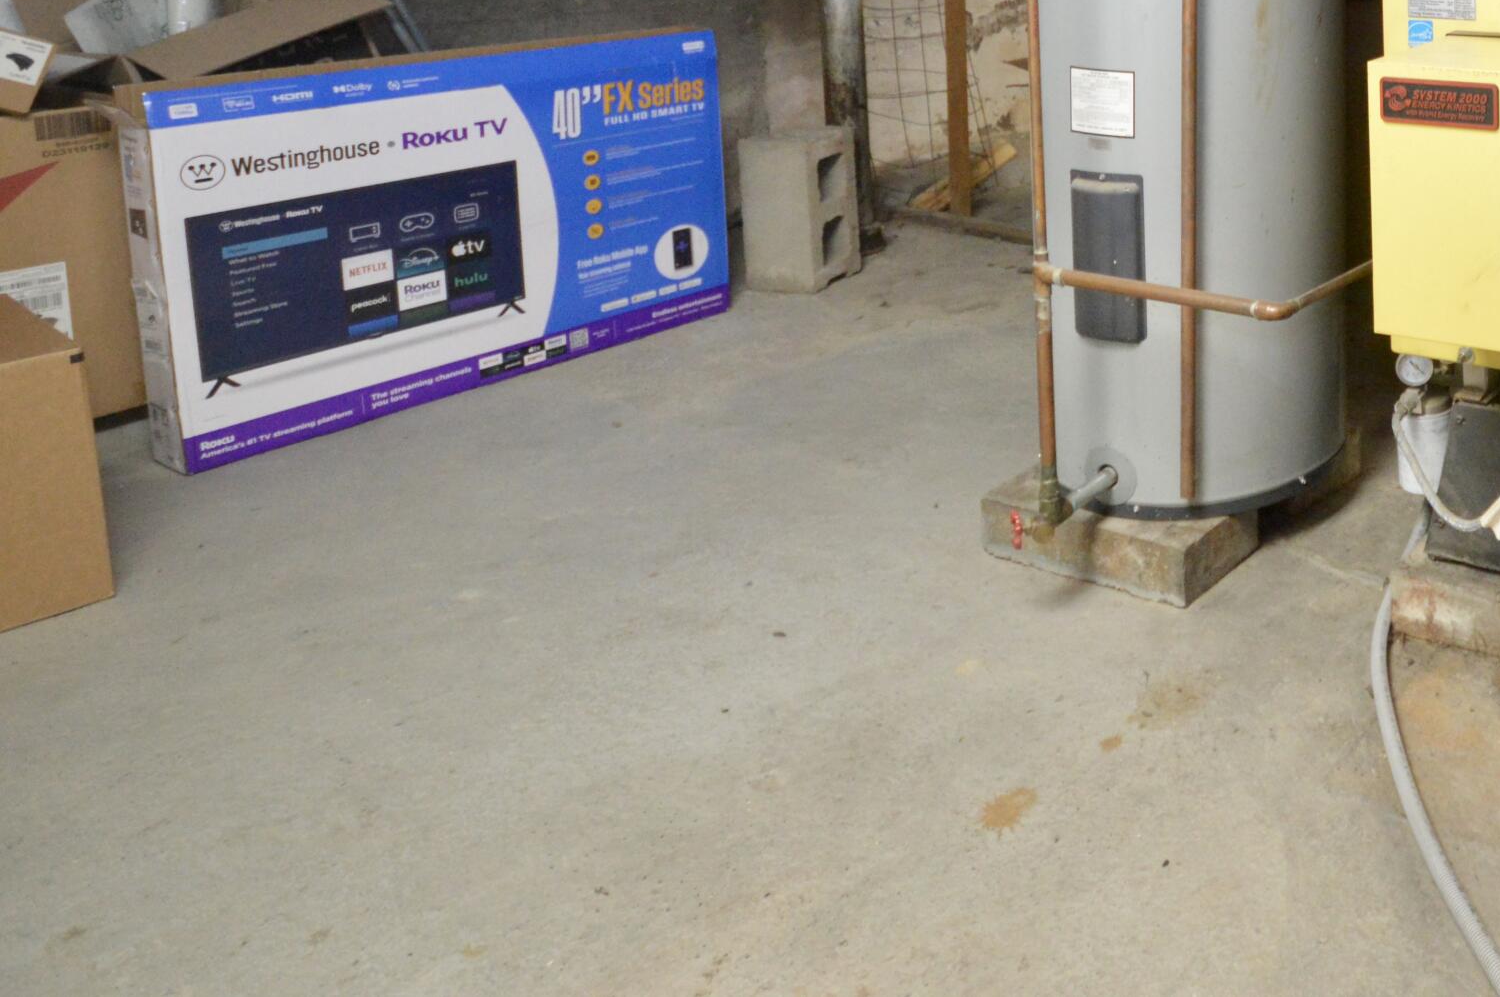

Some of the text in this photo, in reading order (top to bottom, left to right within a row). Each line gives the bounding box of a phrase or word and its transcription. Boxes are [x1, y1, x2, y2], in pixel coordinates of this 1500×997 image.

[603, 79, 634, 115] FX
[638, 77, 705, 109] Series
[1413, 89, 1488, 104] SYSTEM 2000
[604, 102, 704, 126] FULL HD SMART TV
[1412, 101, 1486, 114] ENERGY KINETICS
[231, 139, 380, 177] Westinghouse
[474, 117, 507, 138] TV
[311, 205, 323, 213] TV
[349, 262, 388, 278] NETFLIX
[454, 272, 488, 287] hulu
[351, 295, 388, 313] peacock
[371, 366, 472, 401] The streaming channels
[371, 392, 409, 409] you love
[258, 433, 271, 443] TV
[273, 420, 316, 439] streaming
[317, 410, 353, 426] platform
